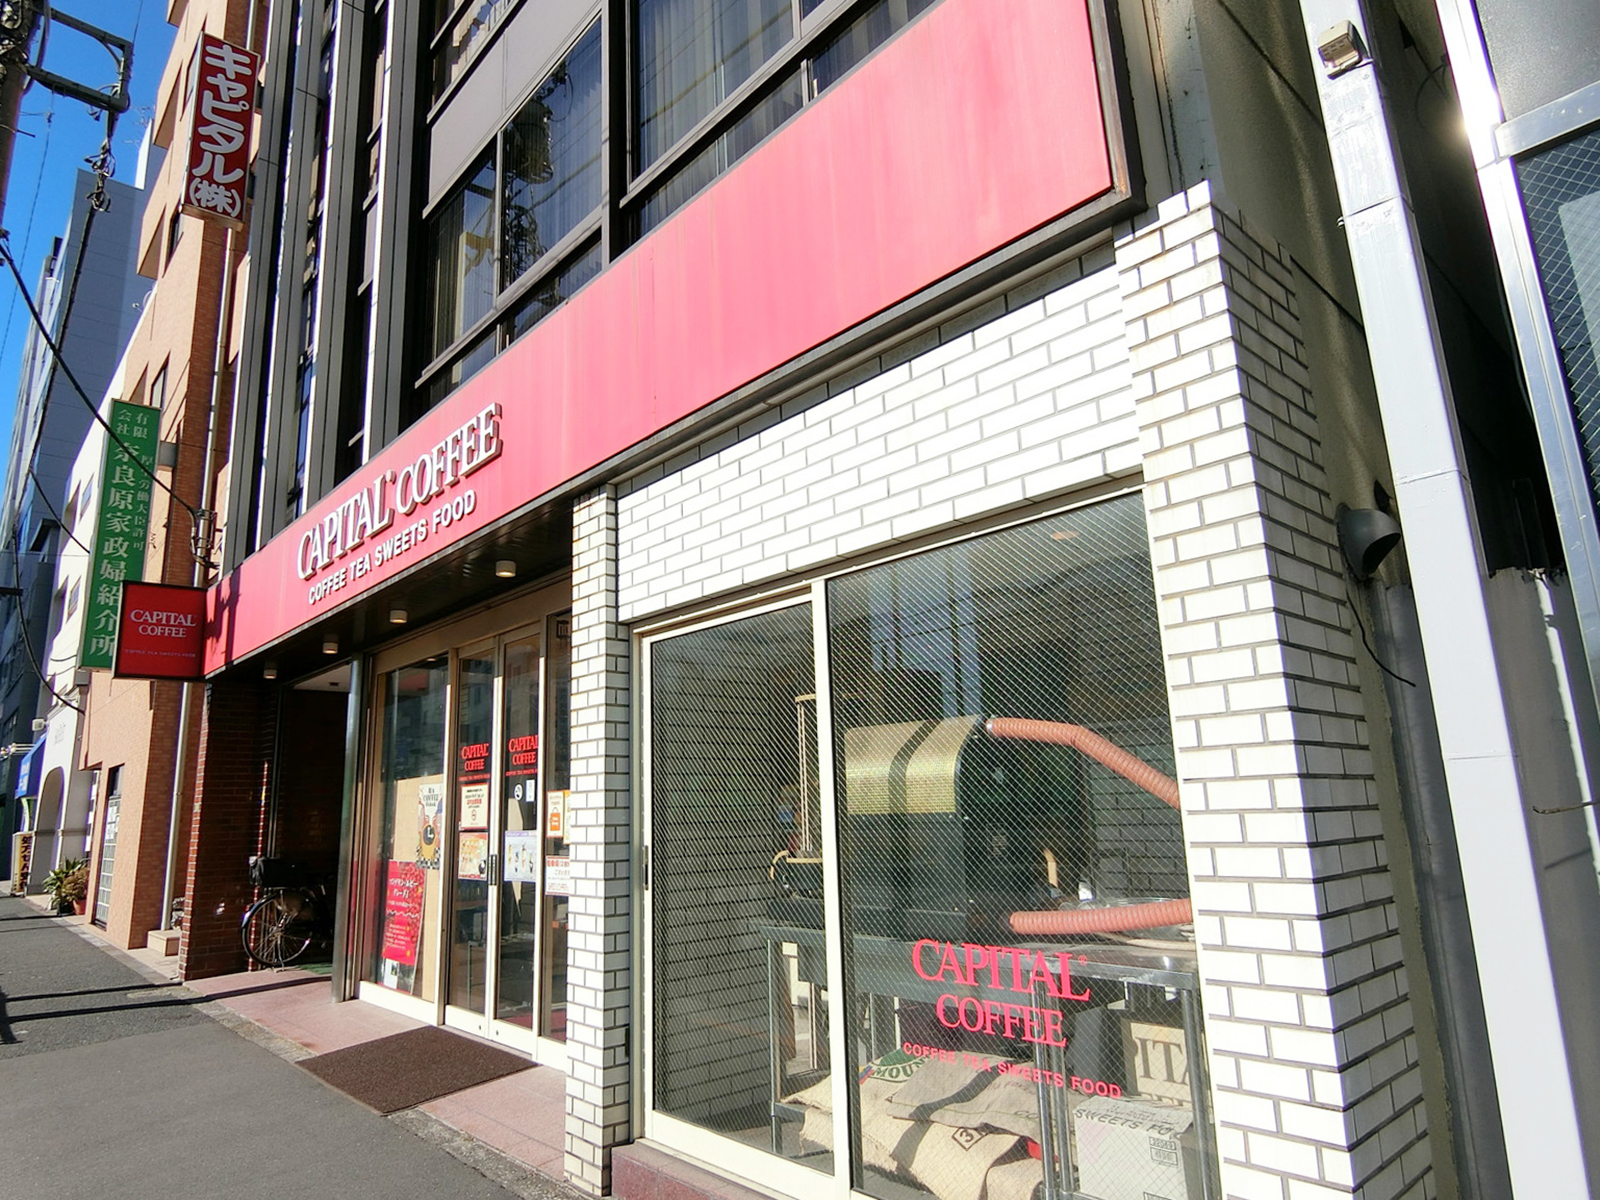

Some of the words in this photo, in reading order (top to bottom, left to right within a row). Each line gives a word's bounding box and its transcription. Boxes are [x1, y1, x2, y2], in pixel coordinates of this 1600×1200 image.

[396, 402, 502, 515] COFFEE
[308, 567, 348, 605] COFFEE
[350, 553, 372, 581] TEA
[374, 518, 428, 568] SWEETS
[432, 489, 477, 534] FOOD
[138, 624, 187, 638] COFFEE
[464, 759, 485, 771] COFFEE
[512, 752, 536, 765] COFFEE
[936, 993, 1067, 1047] COFFEE
[903, 1042, 957, 1065] COFFEE
[963, 1053, 992, 1072] TEA
[997, 1061, 1065, 1088] SWEETS
[1071, 1076, 1122, 1099] FOOD
